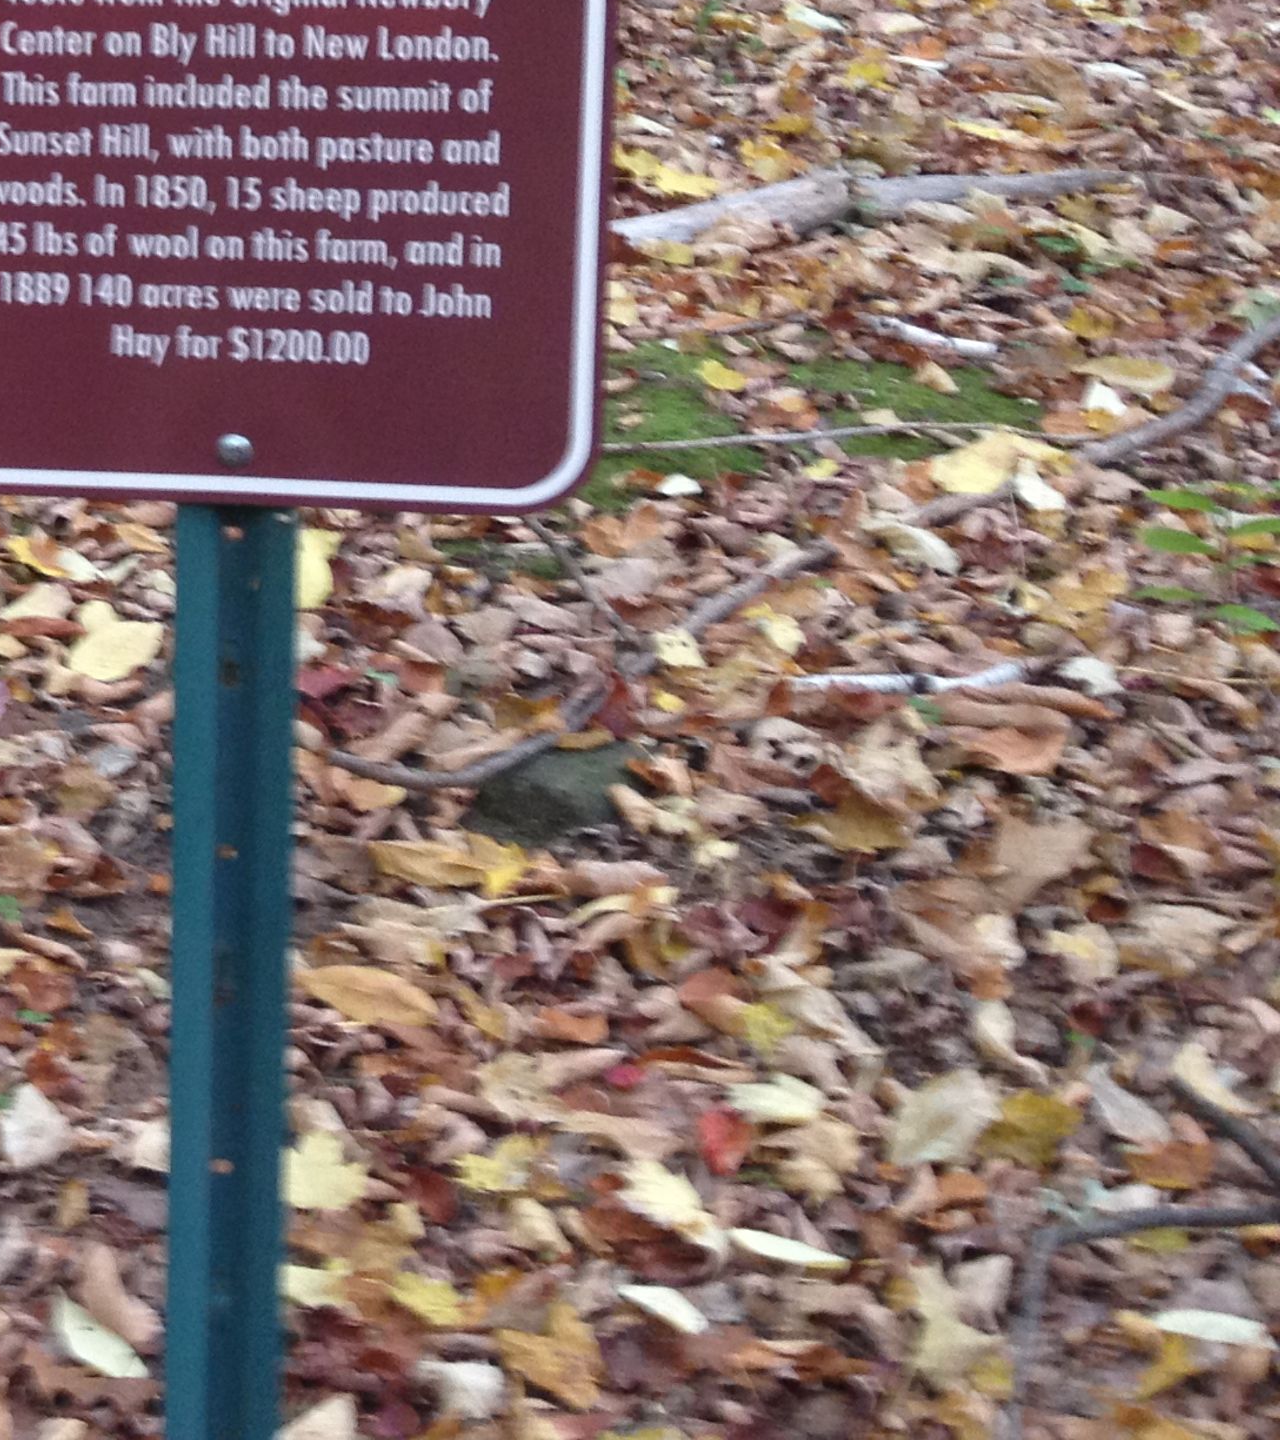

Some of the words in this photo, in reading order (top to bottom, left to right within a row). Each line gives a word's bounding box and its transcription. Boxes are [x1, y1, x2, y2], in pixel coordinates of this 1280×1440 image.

[0, 20, 97, 56] Center
[104, 31, 142, 57] on
[150, 22, 198, 66] Bly
[205, 22, 256, 58] Hill
[263, 28, 295, 59] to
[303, 25, 369, 60] New
[377, 25, 499, 62] London.
[0, 71, 61, 106] This
[66, 71, 137, 107] farm
[144, 73, 271, 110] included
[277, 74, 329, 111] the
[337, 80, 452, 113] summit
[459, 78, 494, 114] of
[99, 123, 160, 163] Hill,
[168, 124, 233, 160] with
[240, 125, 309, 161] both
[316, 132, 434, 171] pasture
[441, 130, 501, 165] and
[94, 173, 126, 208] In
[135, 174, 217, 215] 1850,
[226, 176, 262, 211] 15
[270, 177, 362, 222] sheep
[368, 180, 510, 223] produced
[33, 221, 79, 257] lbs
[84, 223, 118, 257] of
[128, 225, 199, 259] wool
[204, 235, 245, 260] on
[250, 227, 310, 263] this
[315, 228, 398, 270] farm,
[404, 232, 464, 267] and
[470, 234, 502, 268] in
[0, 271, 70, 306] 1889
[78, 273, 133, 308] 140
[138, 283, 220, 310] acres
[226, 286, 301, 313] were
[308, 279, 374, 315] sold
[379, 286, 413, 316] to
[418, 283, 492, 319] John
[111, 324, 171, 366] Hay
[175, 324, 223, 360] for
[228, 326, 370, 365] $1200.00
